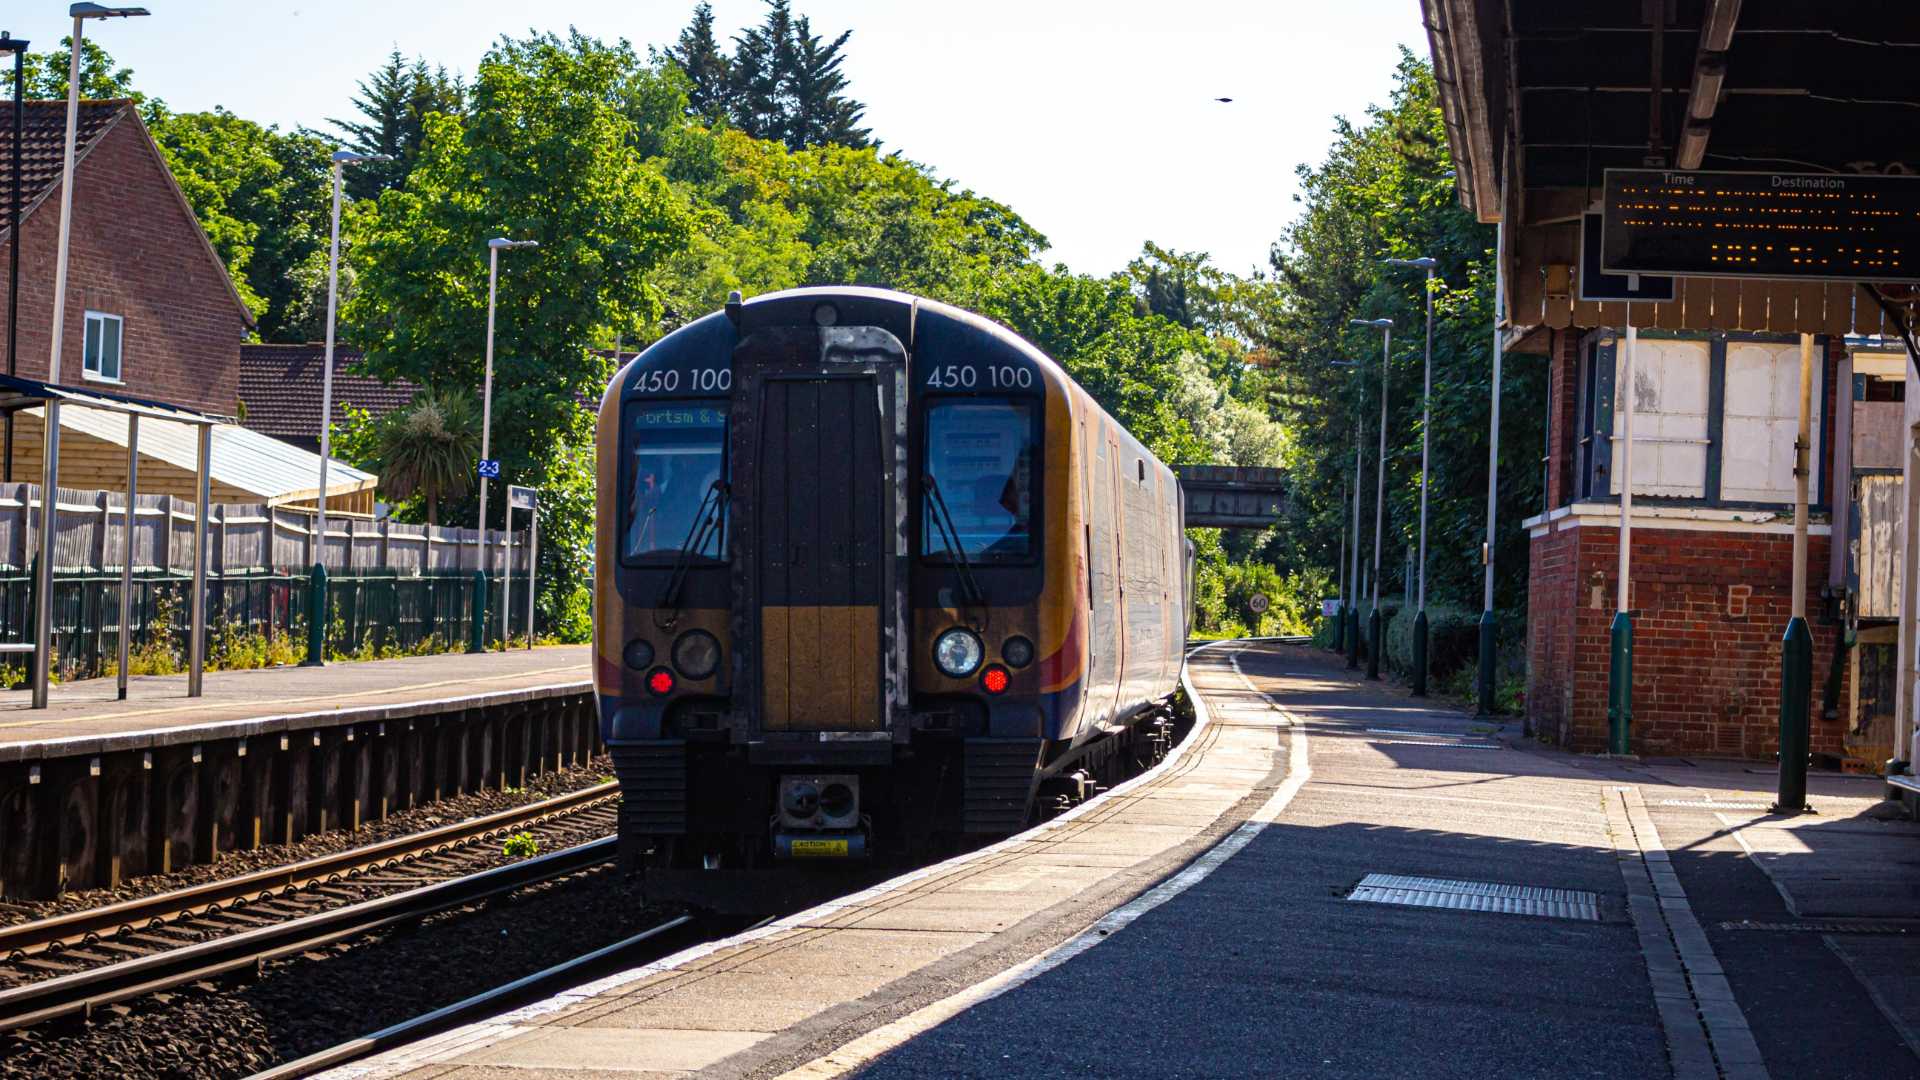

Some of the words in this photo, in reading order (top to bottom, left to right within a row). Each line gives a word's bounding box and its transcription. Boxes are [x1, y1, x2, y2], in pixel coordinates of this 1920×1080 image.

[1663, 173, 1695, 186] Time
[1771, 175, 1845, 190] Destination
[632, 369, 679, 393] 450
[690, 368, 732, 391] 100
[926, 365, 977, 388] 450
[988, 365, 1032, 388] 100
[478, 460, 500, 474] 2-3
[1252, 598, 1267, 609] 60
